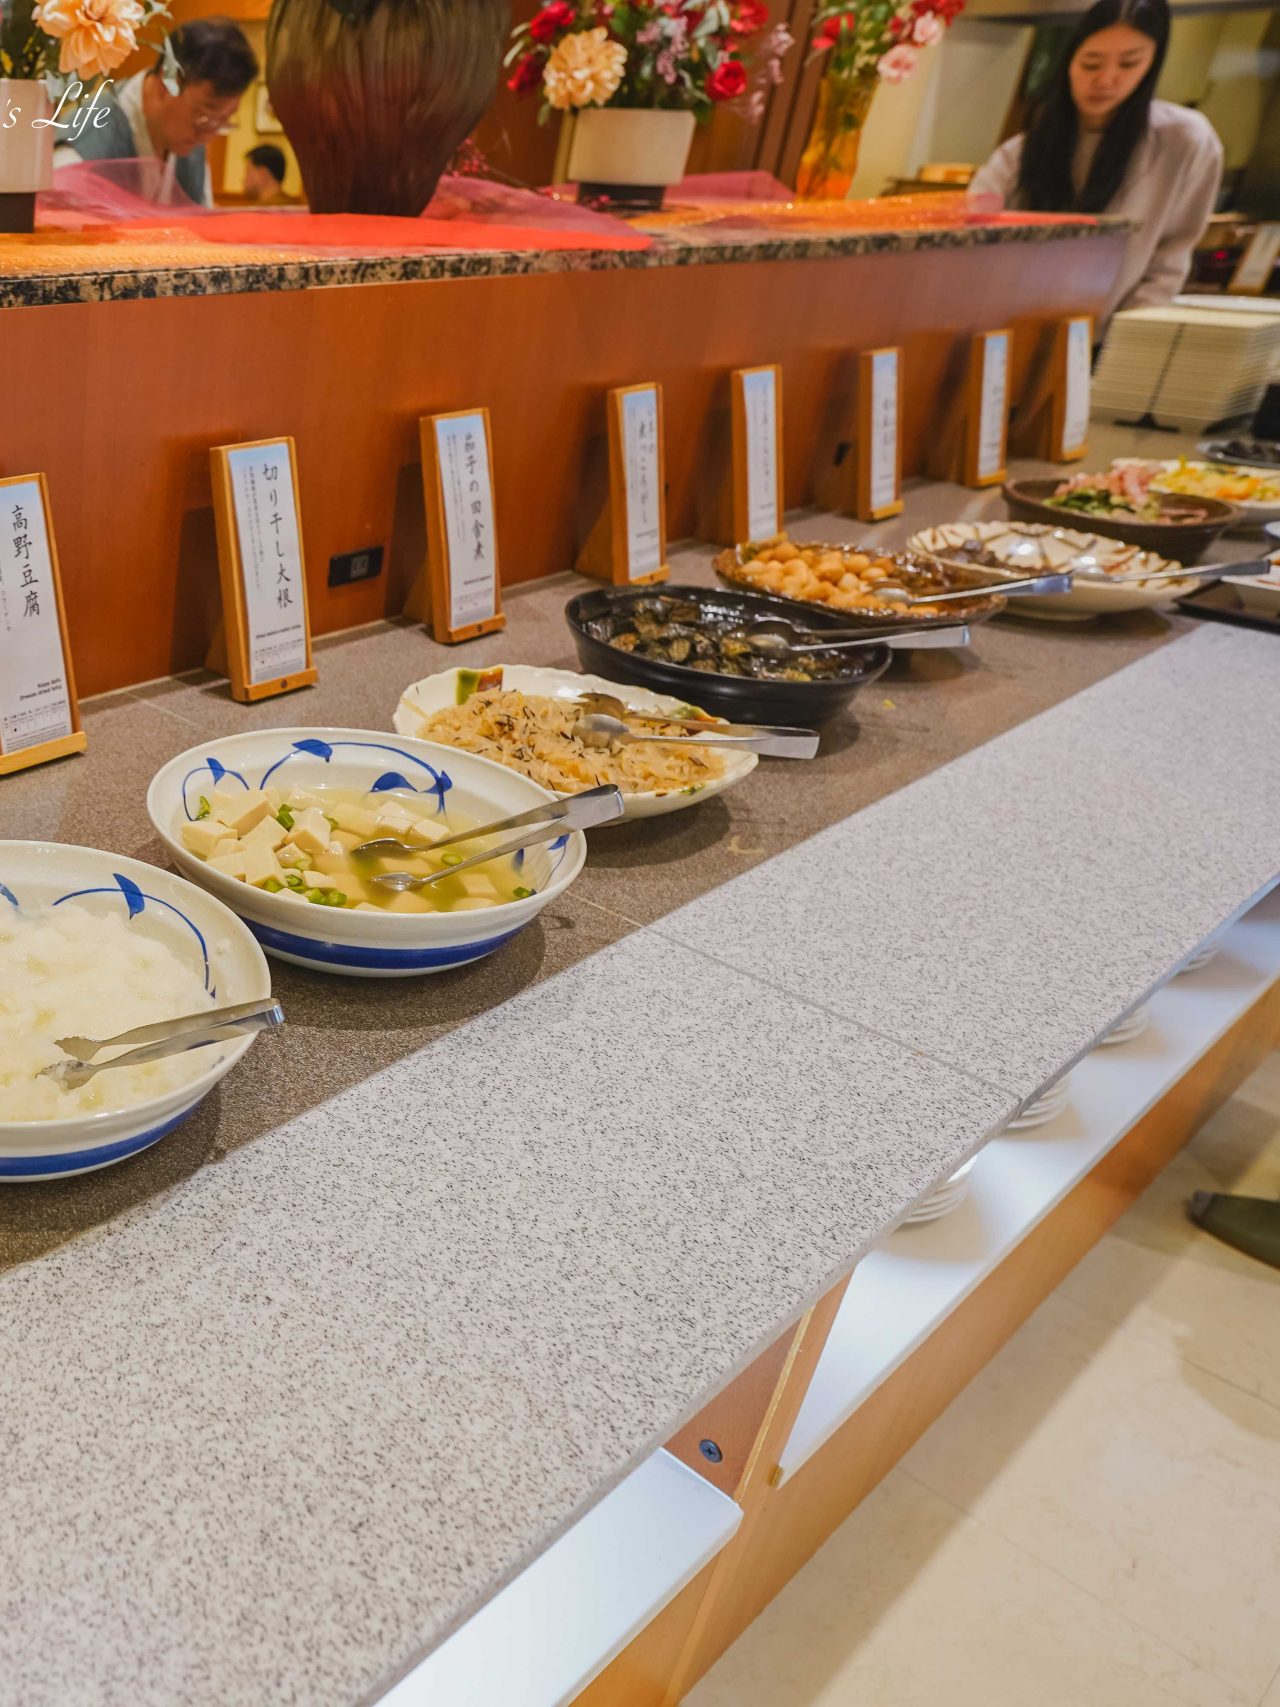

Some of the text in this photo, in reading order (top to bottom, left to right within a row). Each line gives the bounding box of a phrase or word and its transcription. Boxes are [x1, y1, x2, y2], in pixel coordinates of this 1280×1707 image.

[11, 504, 41, 618] 高野豆腐
[262, 463, 294, 609] 切り干し大根
